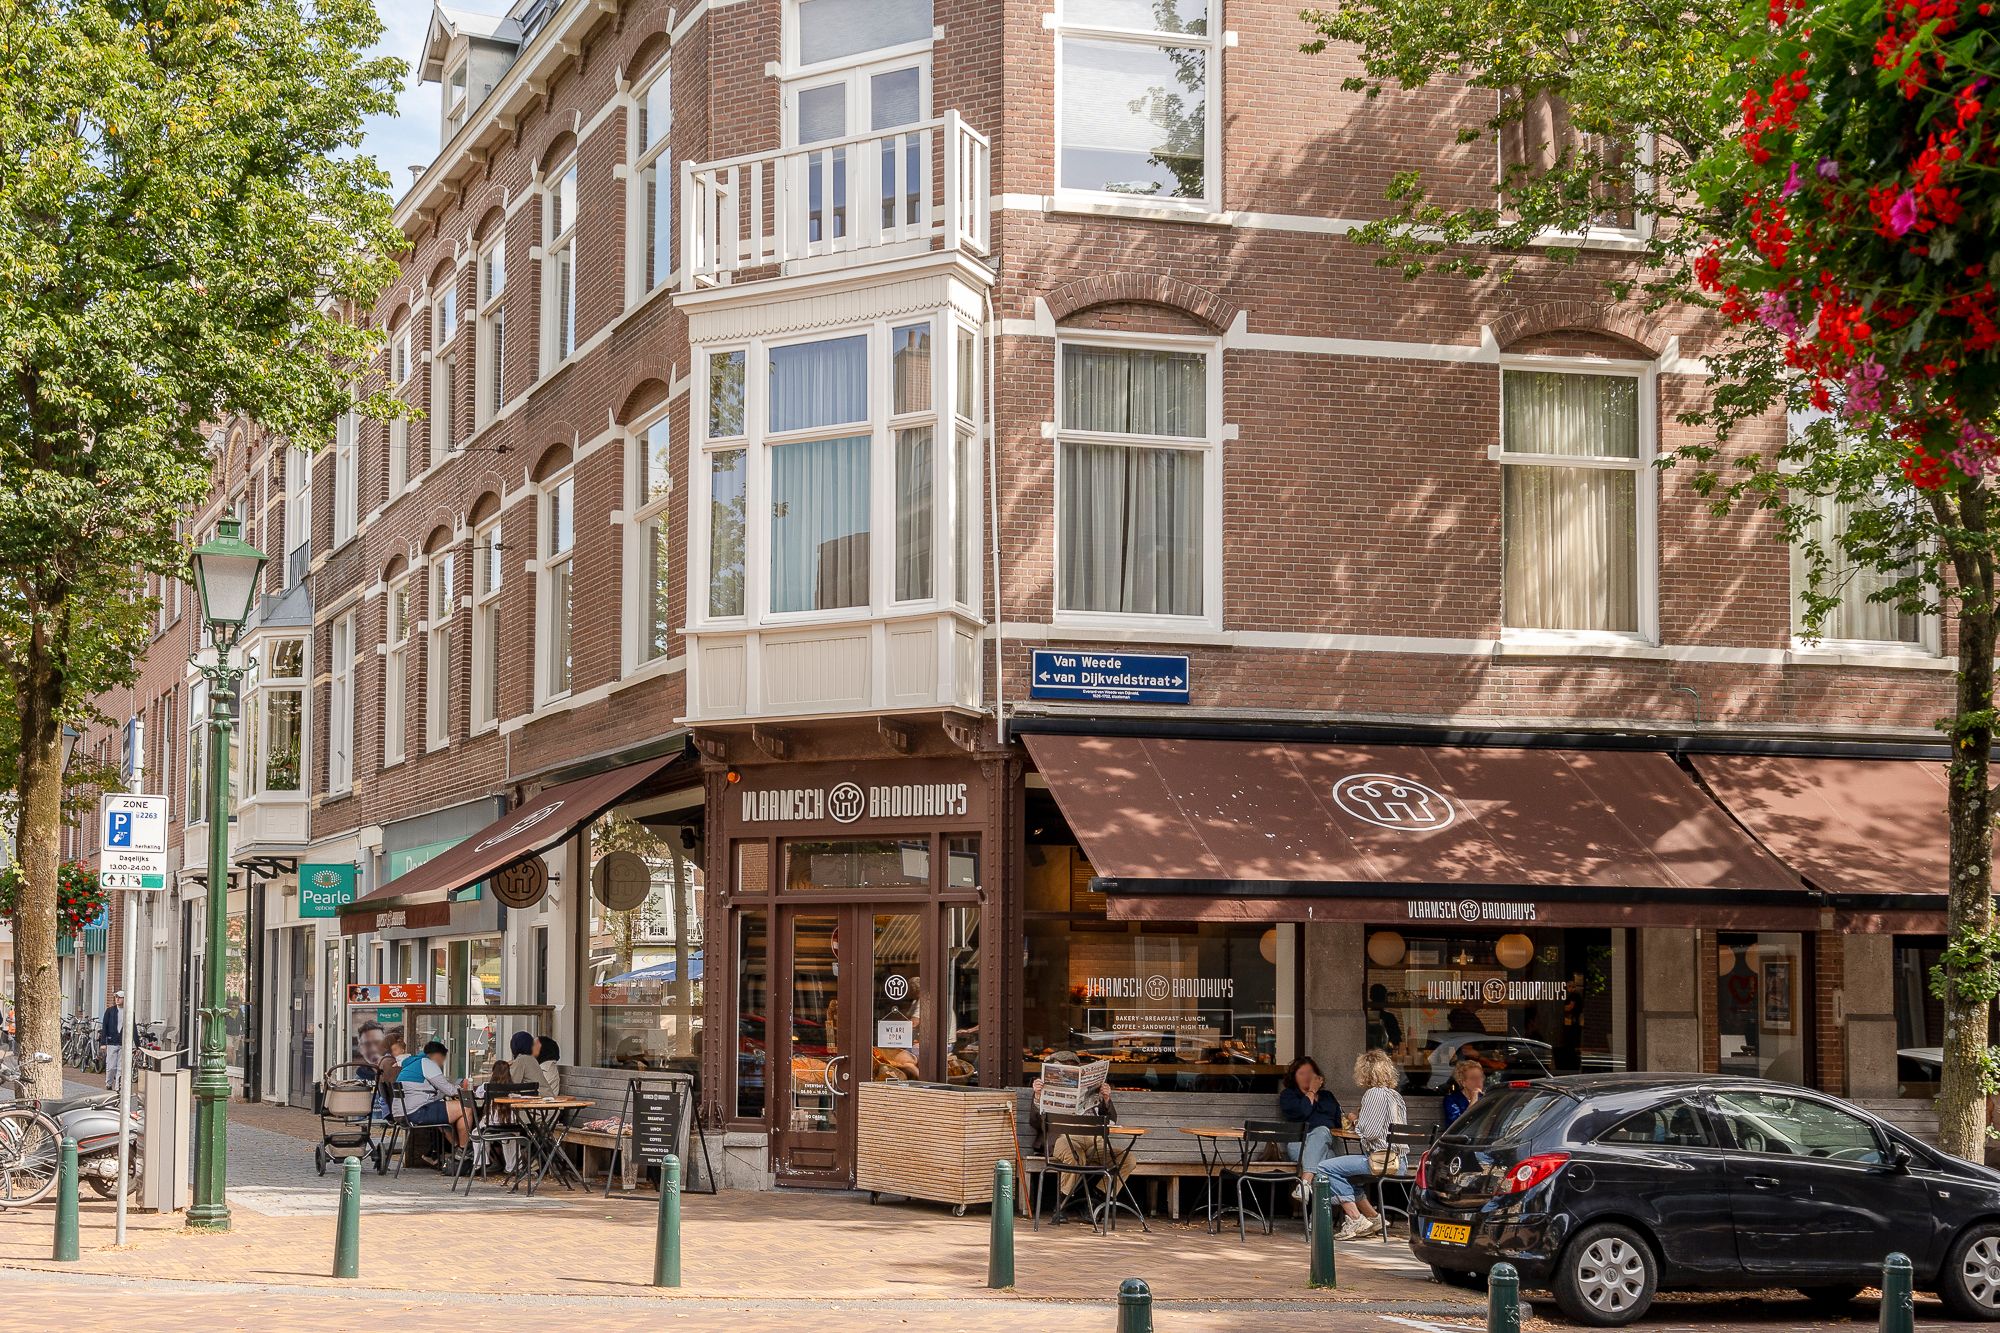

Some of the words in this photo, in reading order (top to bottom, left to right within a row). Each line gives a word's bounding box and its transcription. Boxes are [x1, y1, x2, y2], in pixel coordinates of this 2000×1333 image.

[1053, 656, 1076, 667] Van
[1082, 656, 1122, 668] Weede
[1054, 674, 1076, 683] van
[1082, 673, 1170, 687] Dijkveldstraat
[742, 789, 824, 821] VLAAMSCH
[870, 783, 967, 818] BROODHUYS
[115, 814, 127, 830] P
[303, 890, 350, 904] Pearle
[1408, 901, 1457, 918] VLAAMSCH
[1482, 902, 1536, 920] BROODHUYS
[1087, 978, 1142, 998] VLAAMSCH
[1173, 979, 1233, 998] BROODHUYS
[1428, 980, 1480, 1000] VLAAMSCH
[1509, 981, 1567, 1000] BROODHUYS
[1434, 1225, 1465, 1240] 21-GLT-5
